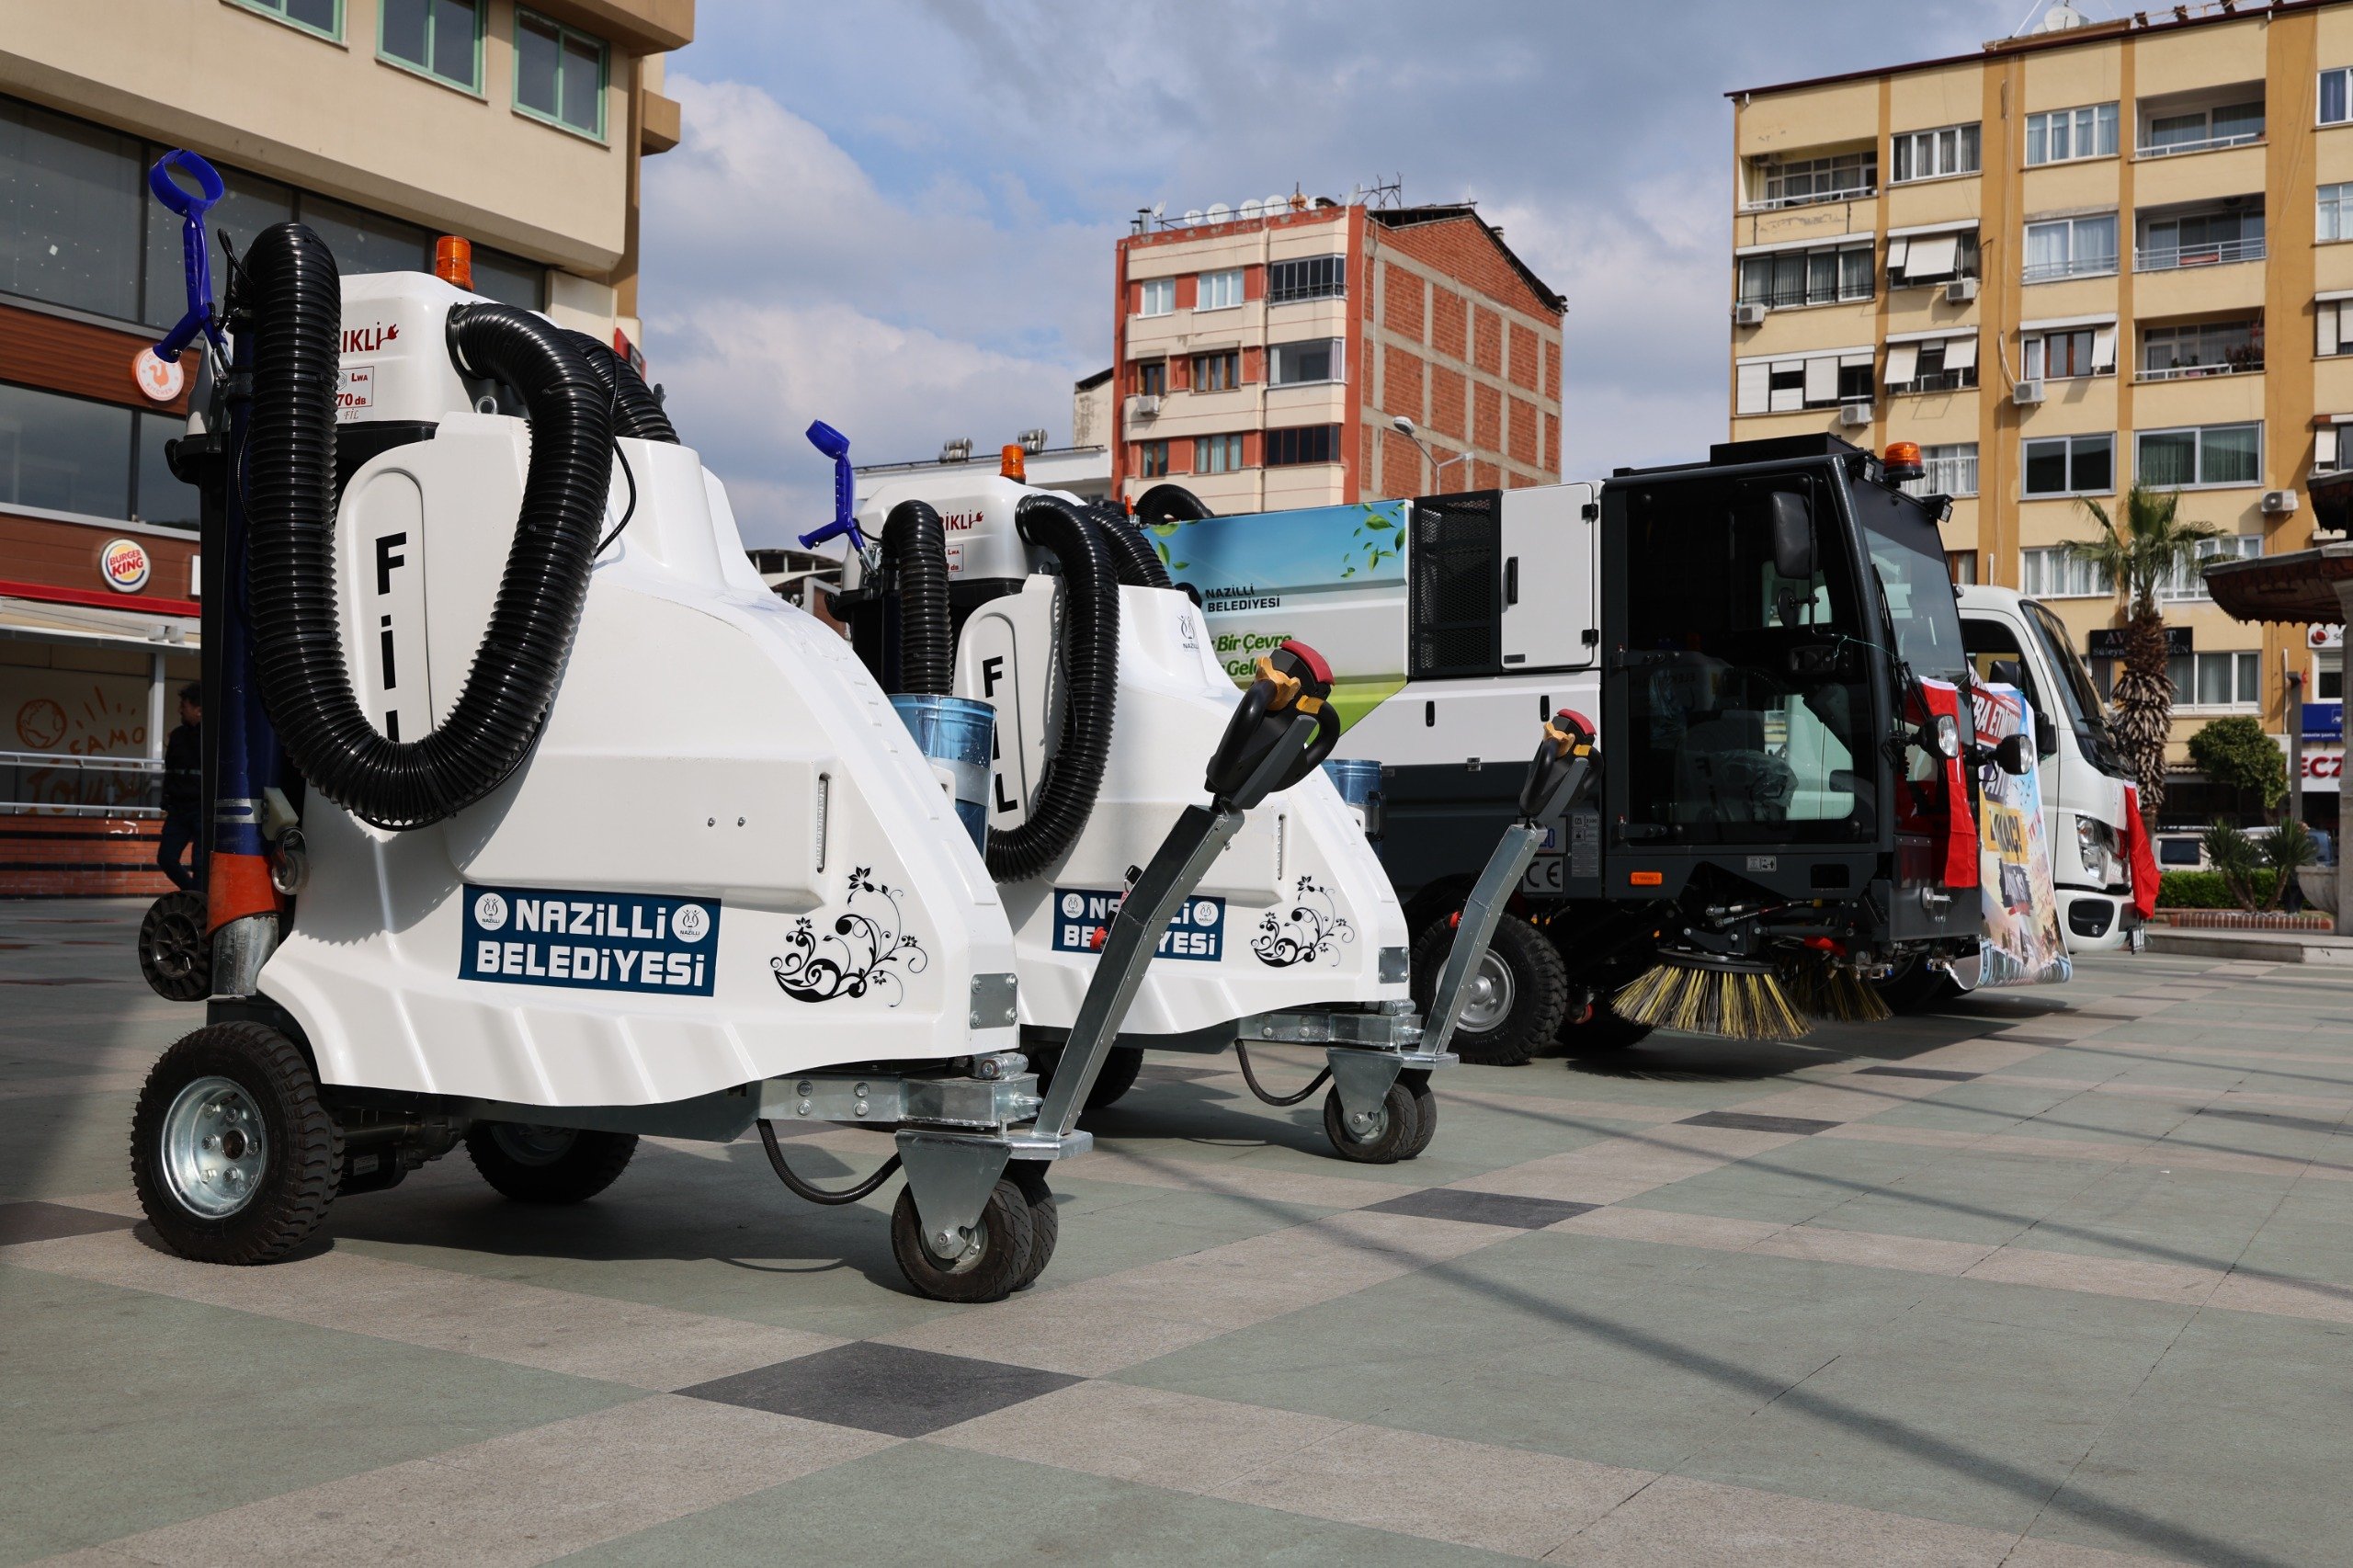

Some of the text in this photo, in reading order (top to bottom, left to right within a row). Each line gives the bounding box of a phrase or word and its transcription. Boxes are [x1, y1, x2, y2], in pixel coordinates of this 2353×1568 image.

[109, 550, 142, 566] BURGER
[112, 557, 143, 577] KING
[1205, 583, 1256, 598] NAZİLLİ
[1207, 595, 1280, 612] BELEDİYESİ
[1216, 634, 1241, 652] Bir
